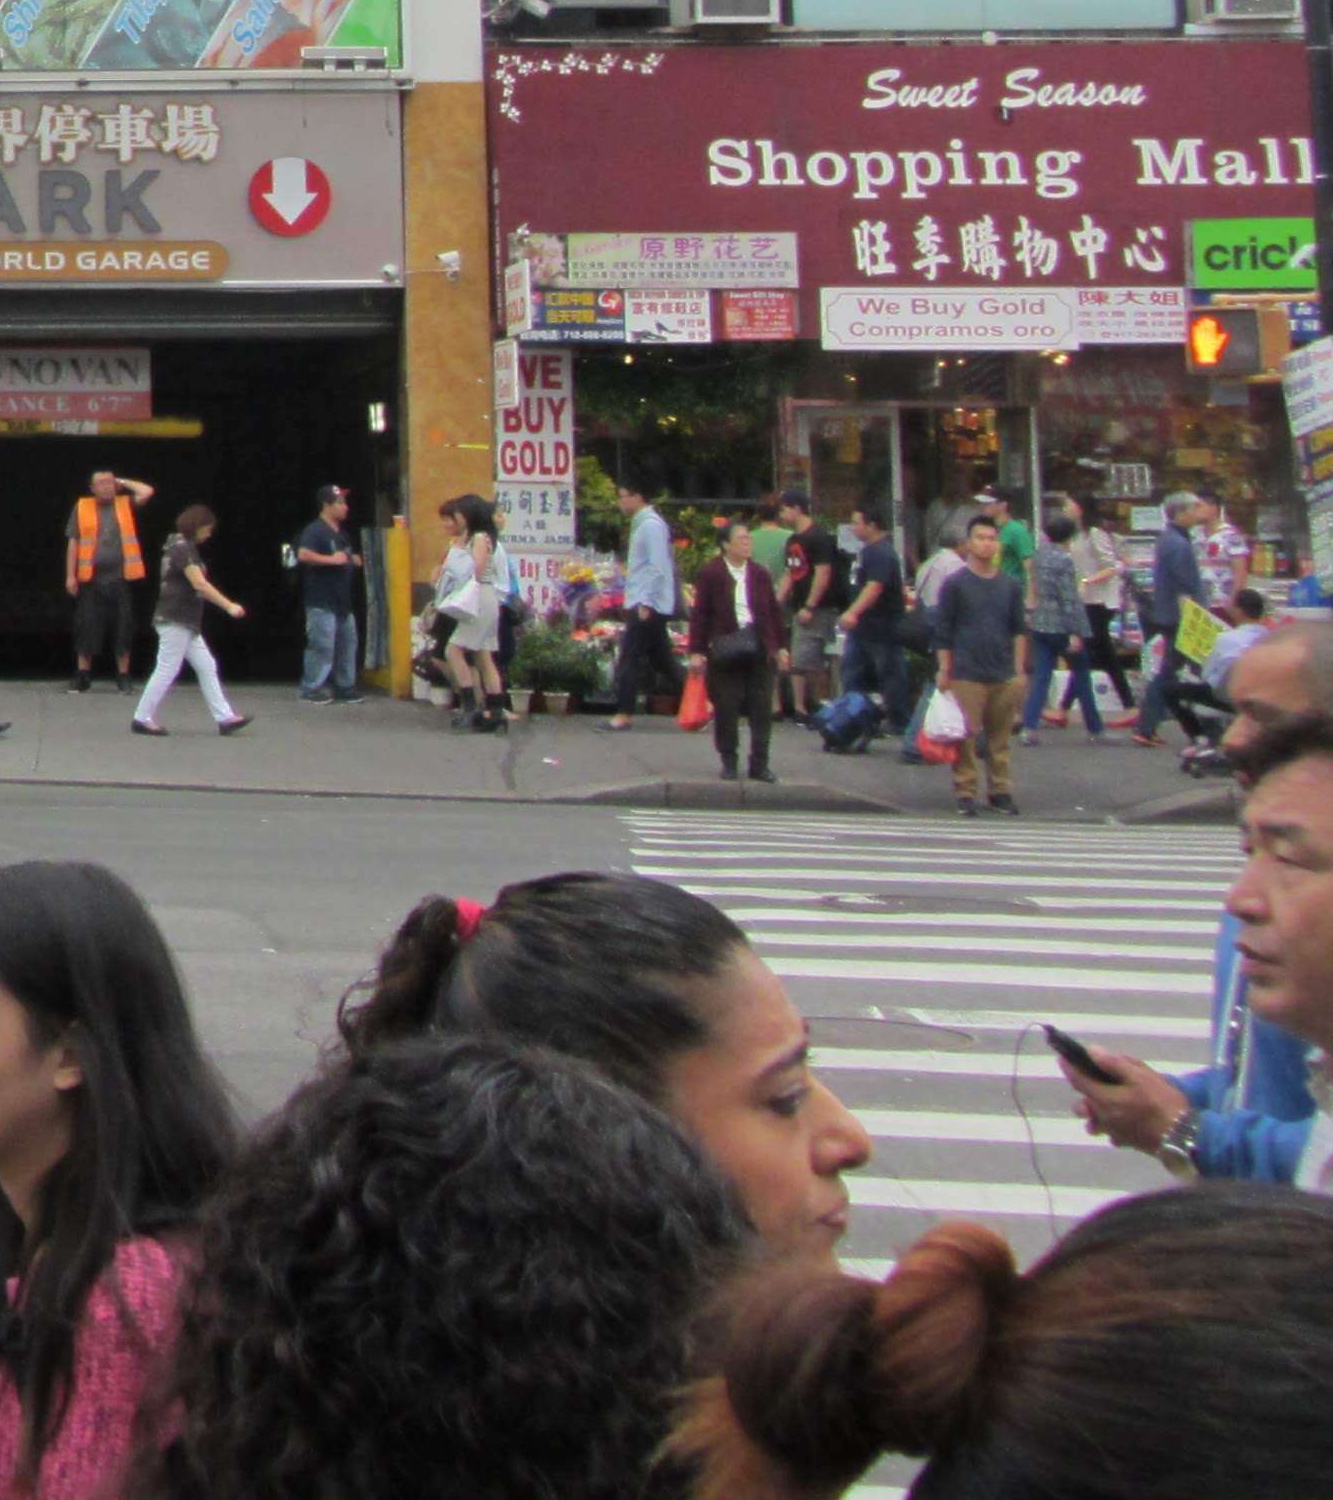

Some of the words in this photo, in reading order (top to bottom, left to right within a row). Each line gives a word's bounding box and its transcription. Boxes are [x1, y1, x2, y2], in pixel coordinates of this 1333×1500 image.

[862, 67, 978, 109] Sweet
[1001, 67, 1147, 109] Season
[707, 138, 1082, 199] Shopping
[1134, 137, 1317, 187] Mall
[74, 250, 211, 272] GARAGE
[851, 214, 1169, 282] 旺季購物中心
[857, 297, 900, 316] We
[911, 296, 966, 320] Buy
[978, 295, 1046, 316] Gold
[849, 321, 1006, 341] Compramos
[1014, 322, 1056, 338] oro
[8, 356, 62, 386] NO
[66, 355, 141, 386] VAN
[502, 397, 568, 434] BUY
[499, 440, 571, 476] GOLD
